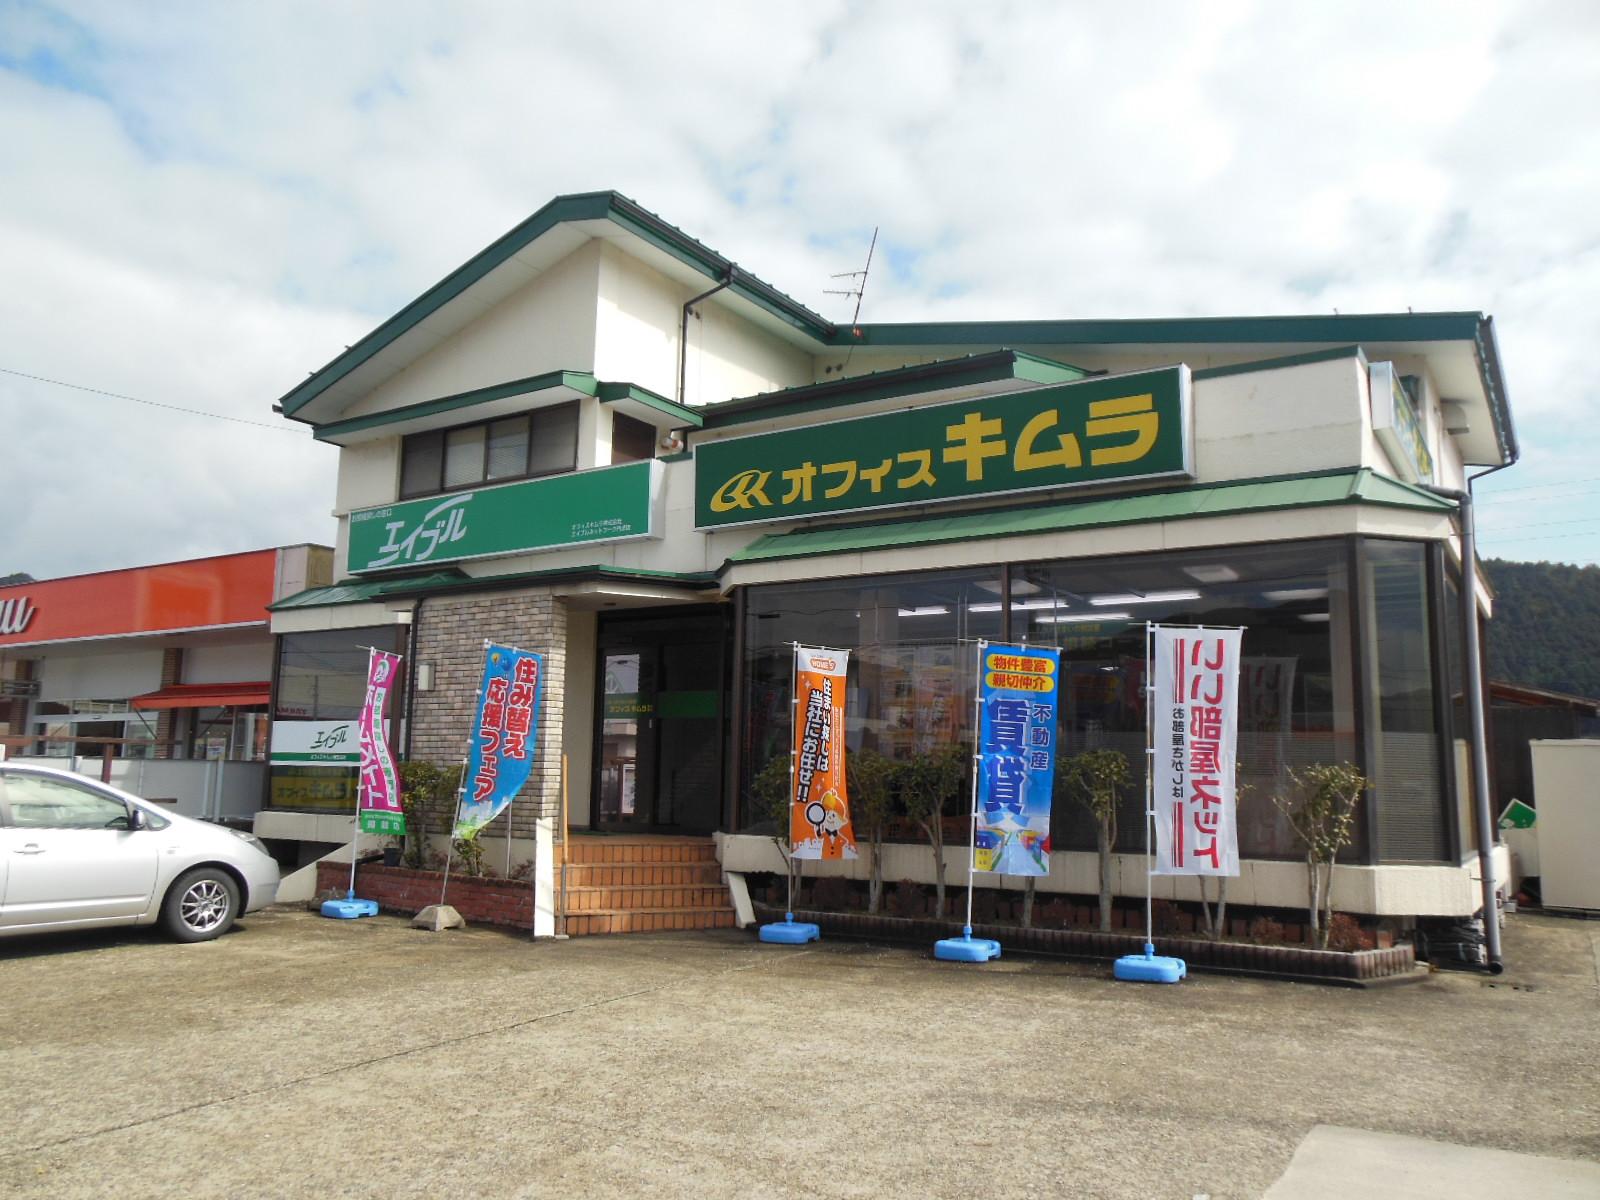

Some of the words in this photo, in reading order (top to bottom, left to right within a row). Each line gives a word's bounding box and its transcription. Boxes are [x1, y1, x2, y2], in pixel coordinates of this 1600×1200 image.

[782, 393, 1159, 505] オフィスキムラ
[368, 494, 473, 567] エイブル
[503, 657, 539, 759] 住み替え
[992, 673, 1046, 690] 親切仲介
[994, 656, 1047, 673] 物件豊富
[310, 724, 349, 749] エイブル
[474, 676, 509, 801] 応援フェア
[796, 688, 823, 802] 当社にお任せ!!
[817, 676, 832, 772] 住まい探しは
[985, 697, 1029, 815] 賃貸
[1031, 704, 1053, 770] 不動産
